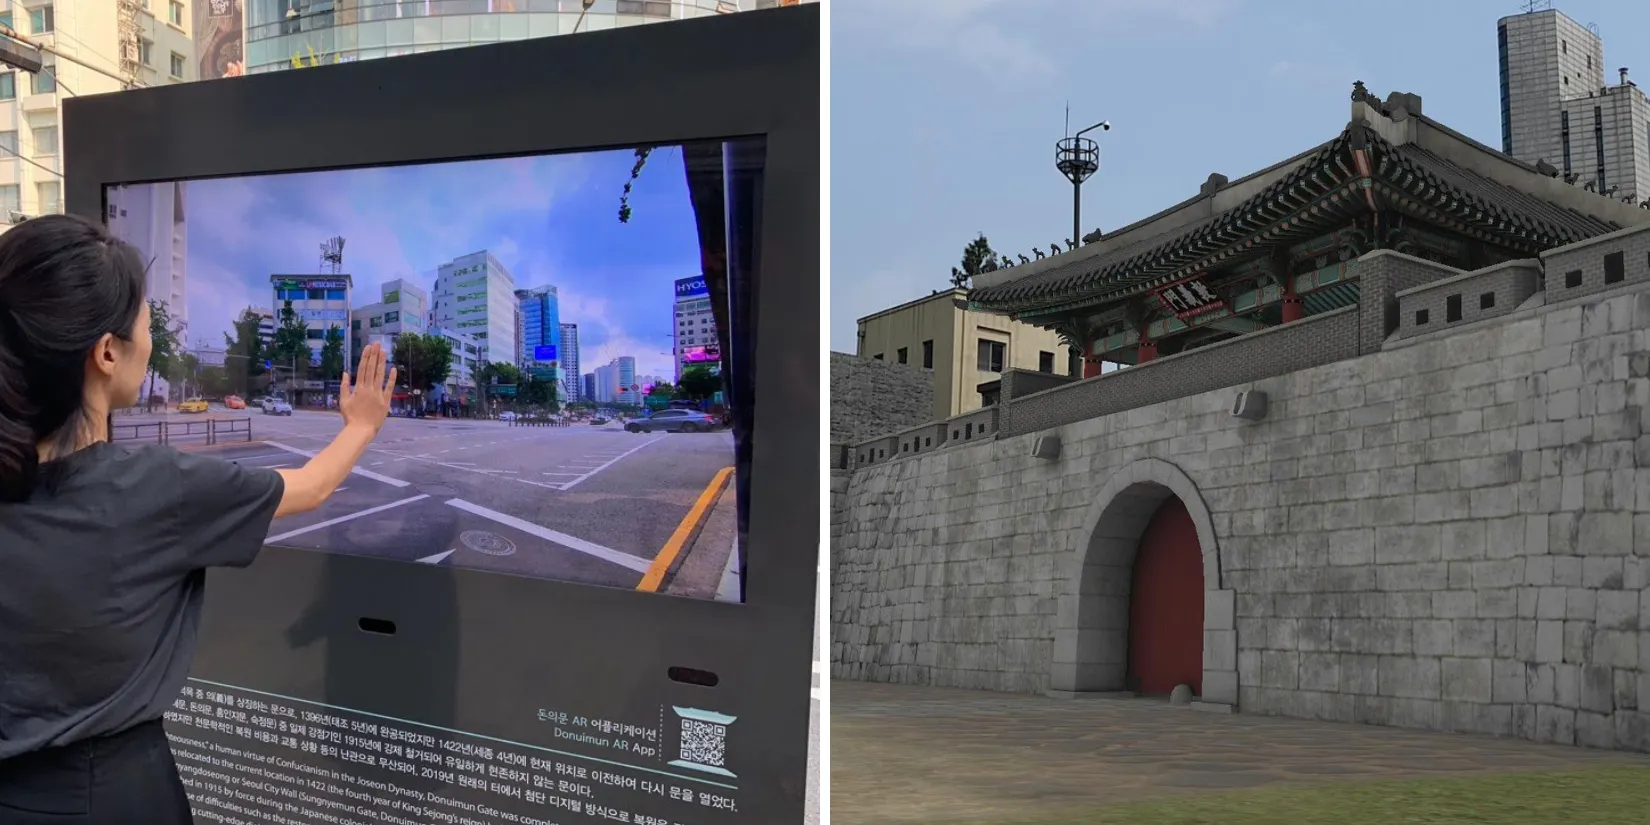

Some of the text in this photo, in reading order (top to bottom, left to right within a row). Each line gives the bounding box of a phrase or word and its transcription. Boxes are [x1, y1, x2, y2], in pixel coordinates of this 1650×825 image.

[196, 688, 204, 700] 중
[237, 697, 268, 712] 상징하는
[270, 704, 298, 720] 문으로,
[300, 710, 348, 728] 1396년(태조
[351, 721, 377, 736] 5년)에
[380, 726, 435, 748] 완공되었지만
[439, 739, 494, 760] 1422년(세종
[497, 751, 526, 767] 4년)에
[530, 757, 552, 772] 현재
[556, 762, 588, 779] 위치로
[592, 770, 636, 790] 이전하여
[641, 780, 664, 796] 다시
[669, 786, 694, 802] 문을
[698, 792, 738, 812] 열었다.
[537, 708, 657, 742] 돈의문 AR 어플리케이션
[554, 727, 656, 757] Donuimun AR App
[195, 716, 234, 735] 천문학적인
[235, 726, 252, 739] 복원
[254, 730, 278, 744] 비용과
[281, 736, 298, 750] 교통
[300, 740, 318, 753] 상황
[320, 744, 338, 758] 등의
[340, 748, 376, 766] 난관으로
[379, 758, 418, 776] 무산되어,
[422, 768, 454, 784] 2019년
[458, 774, 486, 792] 원래의
[491, 782, 520, 798] 터에서
[525, 790, 546, 804] 첨단
[550, 796, 582, 813] 디지털
[586, 801, 630, 822] 방식으로
[216, 743, 242, 757] human
[243, 750, 265, 762] virtue
[266, 756, 276, 764] of
[276, 758, 330, 776] Confucianism
[332, 770, 340, 780] in
[341, 773, 356, 783] the
[357, 776, 386, 790] Joseon
[388, 784, 426, 801] Dynasty,
[428, 792, 476, 812] Donuimun
[477, 804, 498, 817] Gate
[500, 811, 518, 822] was
[250, 715, 277, 730] 숙정문)
[278, 721, 288, 732] 중
[290, 722, 306, 736] 일제
[308, 727, 342, 743] 강점기인
[344, 735, 382, 752] 1915년에
[384, 742, 402, 756] 강제
[406, 746, 442, 765] 철거되어
[445, 756, 484, 774] 유일하게
[488, 764, 529, 784] 현존하지
[534, 774, 554, 789] 않는
[558, 780, 594, 798] 문이다.
[178, 750, 210, 764] relocated
[212, 758, 220, 766] to
[222, 759, 234, 768] the
[235, 763, 262, 776] current
[264, 769, 295, 784] location
[296, 775, 304, 786] in
[307, 780, 326, 791] 1422
[327, 784, 344, 796] (the
[346, 788, 372, 802] fourth
[372, 796, 390, 806] year
[392, 800, 400, 808] of
[402, 801, 422, 816] King
[423, 806, 458, 824] Sejong's
[195, 780, 202, 789] in
[204, 782, 222, 794] 1915
[224, 786, 234, 798] by
[235, 790, 256, 802] force
[256, 796, 283, 811] during
[284, 803, 298, 814] the
[300, 806, 338, 822] Japanese
[196, 794, 204, 802] of
[205, 796, 242, 814] difficulties
[244, 806, 262, 818] such
[262, 812, 272, 820] as
[272, 814, 286, 824] the
[232, 776, 240, 784] or
[242, 778, 263, 790] Seoul
[264, 784, 280, 796] City
[280, 787, 298, 798] Wall
[298, 791, 355, 812] (Sungnyemun
[357, 806, 378, 820] Gate,
